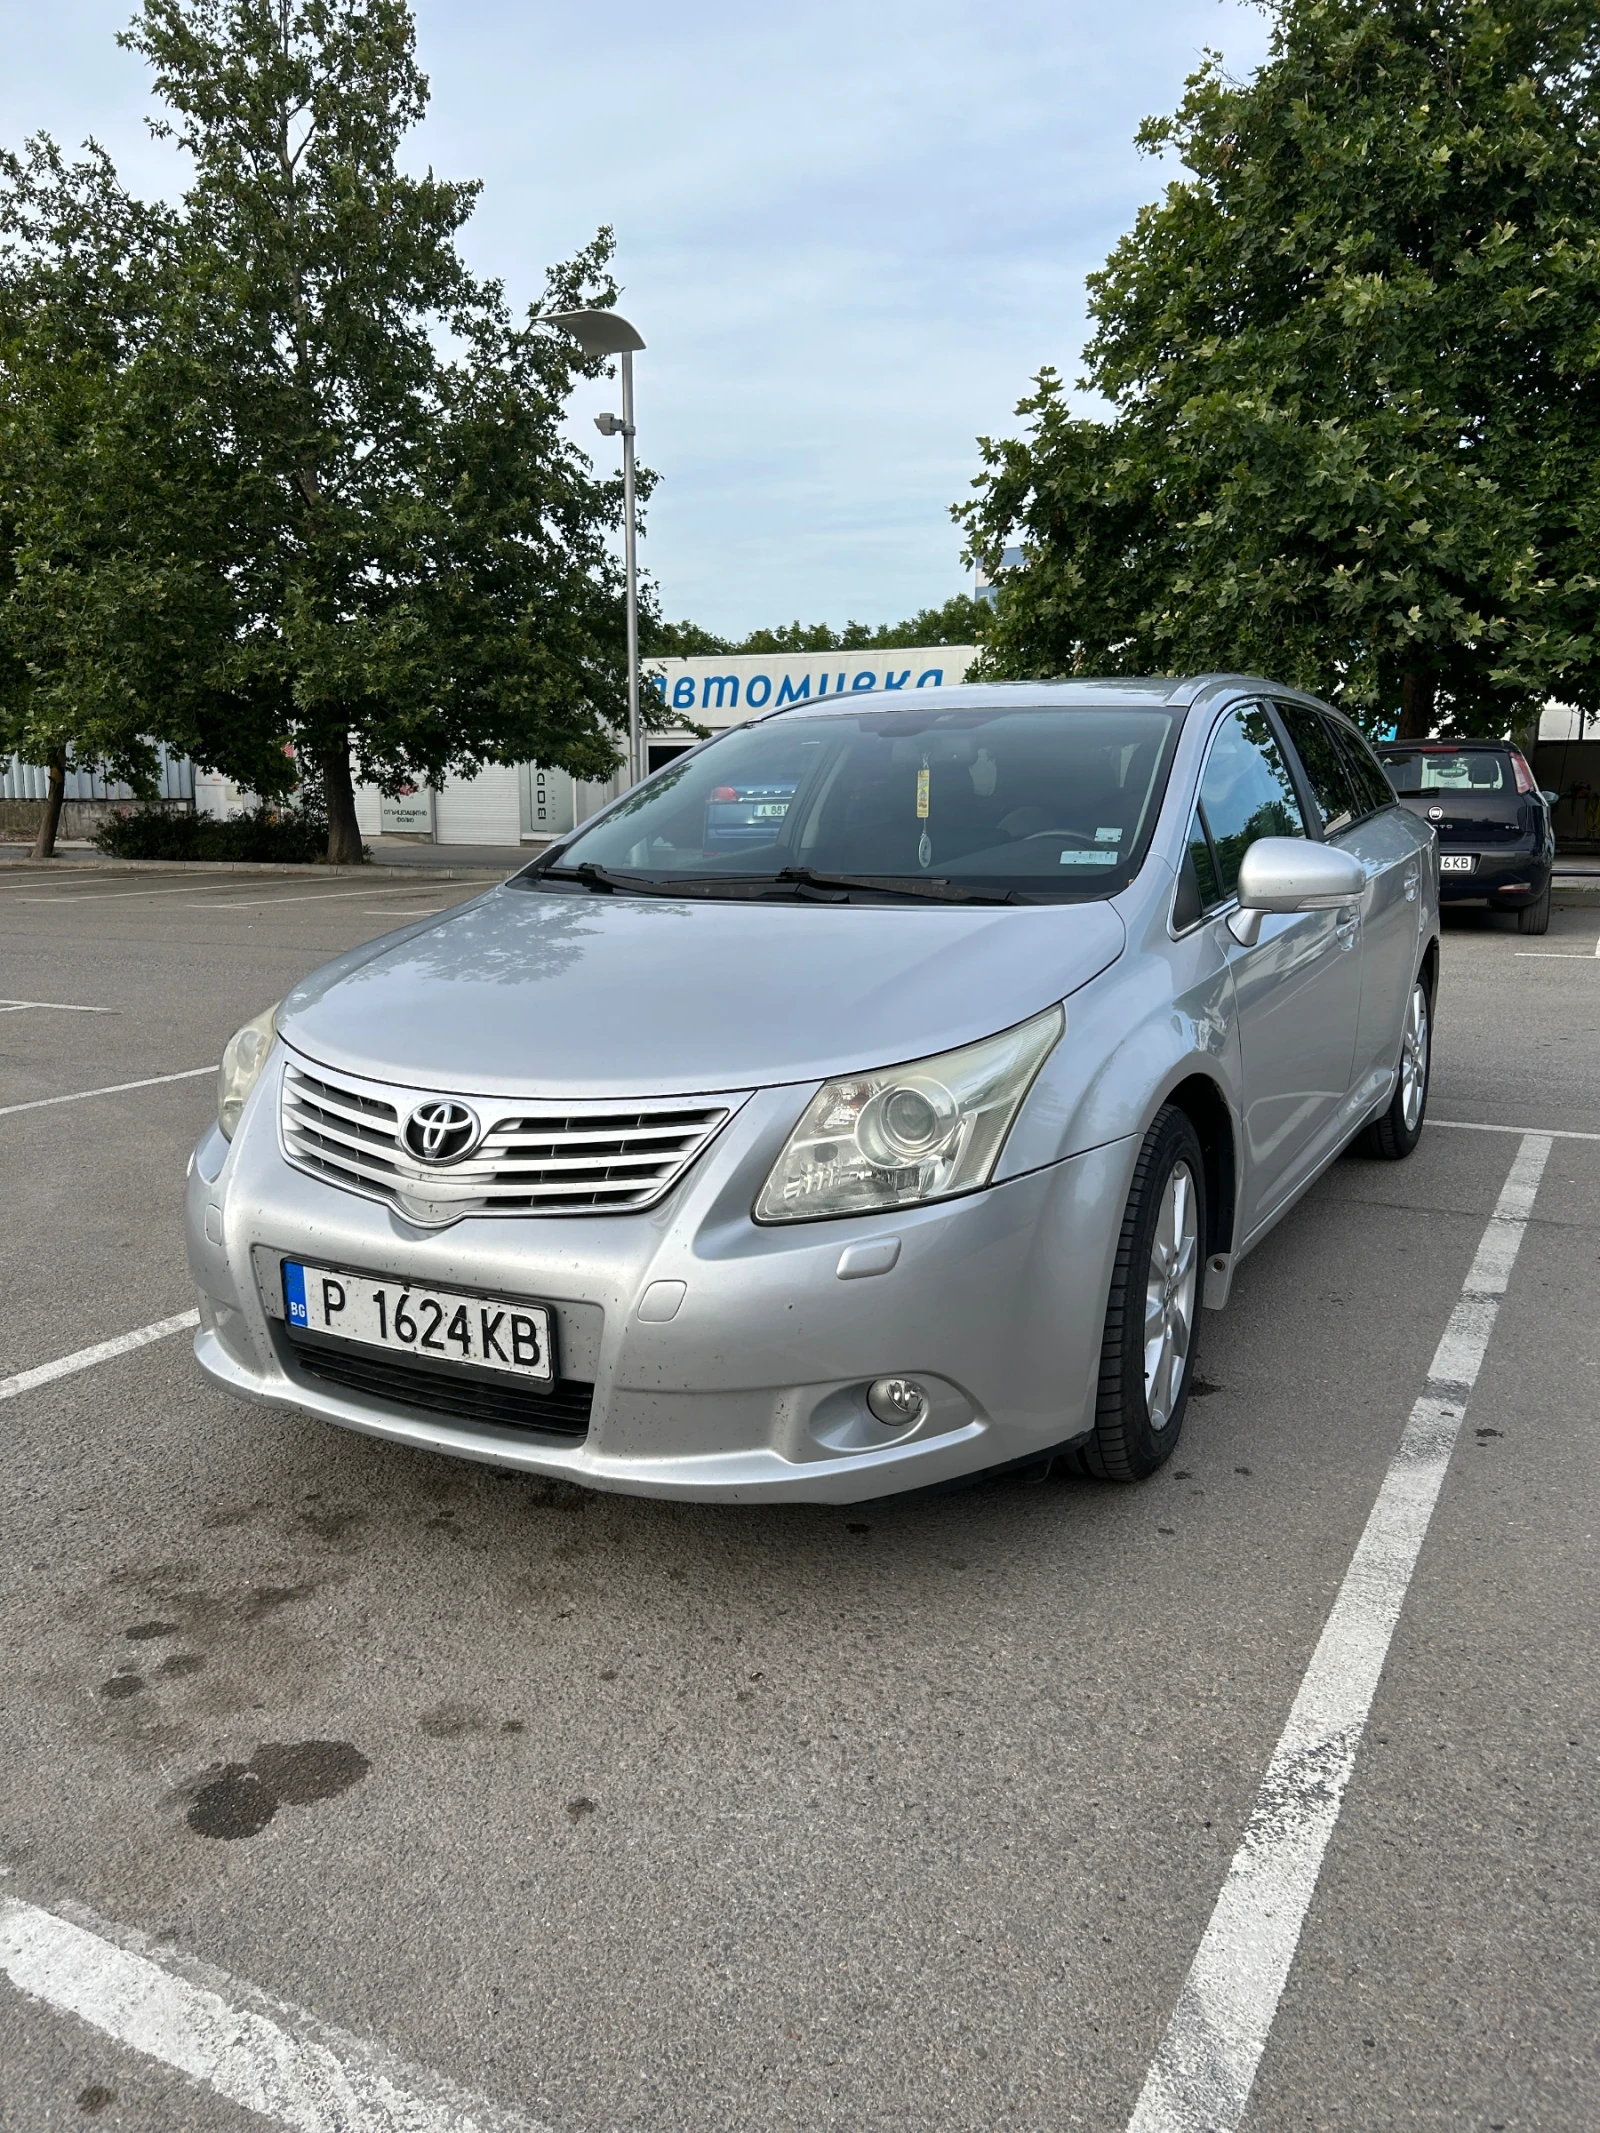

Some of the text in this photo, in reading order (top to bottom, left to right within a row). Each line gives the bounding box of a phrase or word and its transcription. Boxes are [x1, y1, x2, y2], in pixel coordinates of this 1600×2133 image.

[537, 772, 546, 820] BOD
[771, 805, 788, 815] 881
[1440, 857, 1469, 869] 6KB
[290, 1301, 306, 1318] BG
[322, 1277, 346, 1326] P
